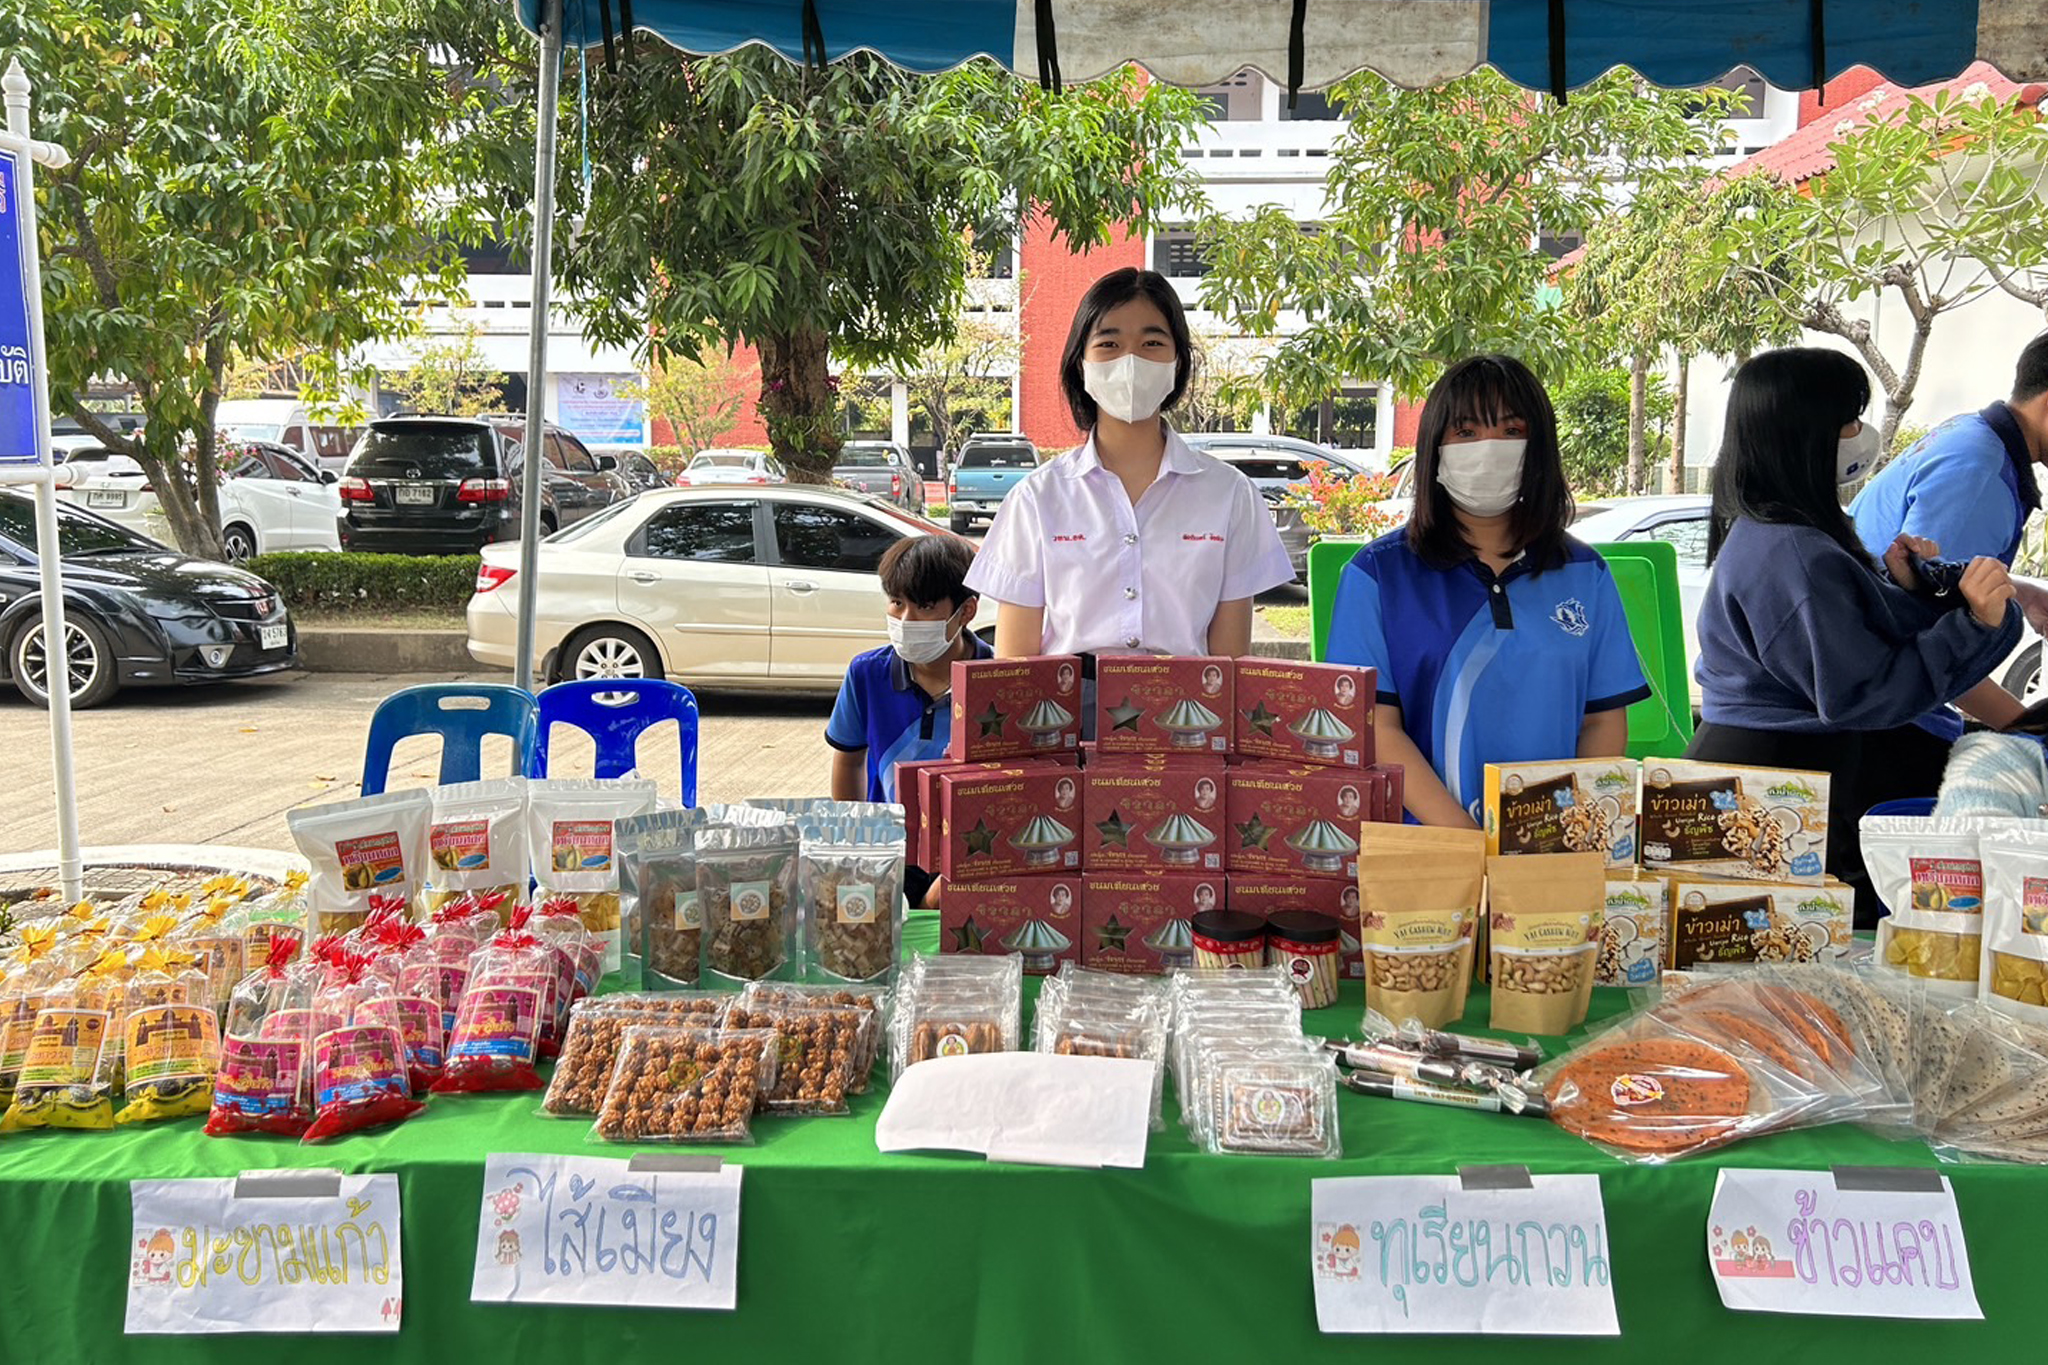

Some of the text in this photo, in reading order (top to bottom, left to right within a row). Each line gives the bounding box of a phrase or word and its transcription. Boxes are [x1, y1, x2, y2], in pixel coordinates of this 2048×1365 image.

[1506, 796, 1552, 819] ข้าวเม่า
[1650, 793, 1707, 811] ข้าวเม่า
[1544, 813, 1559, 825] Rice
[1697, 812, 1716, 822] Rice
[1684, 823, 1714, 836] ธัญพืช
[1685, 915, 1740, 935] ข้าวเม่า
[1731, 933, 1749, 944] Rice
[176, 1196, 391, 1289] มะขามแก้ว
[1787, 1188, 1960, 1290] ข้าวแคบ
[1370, 1197, 1610, 1319] ทุเรียนกวน
